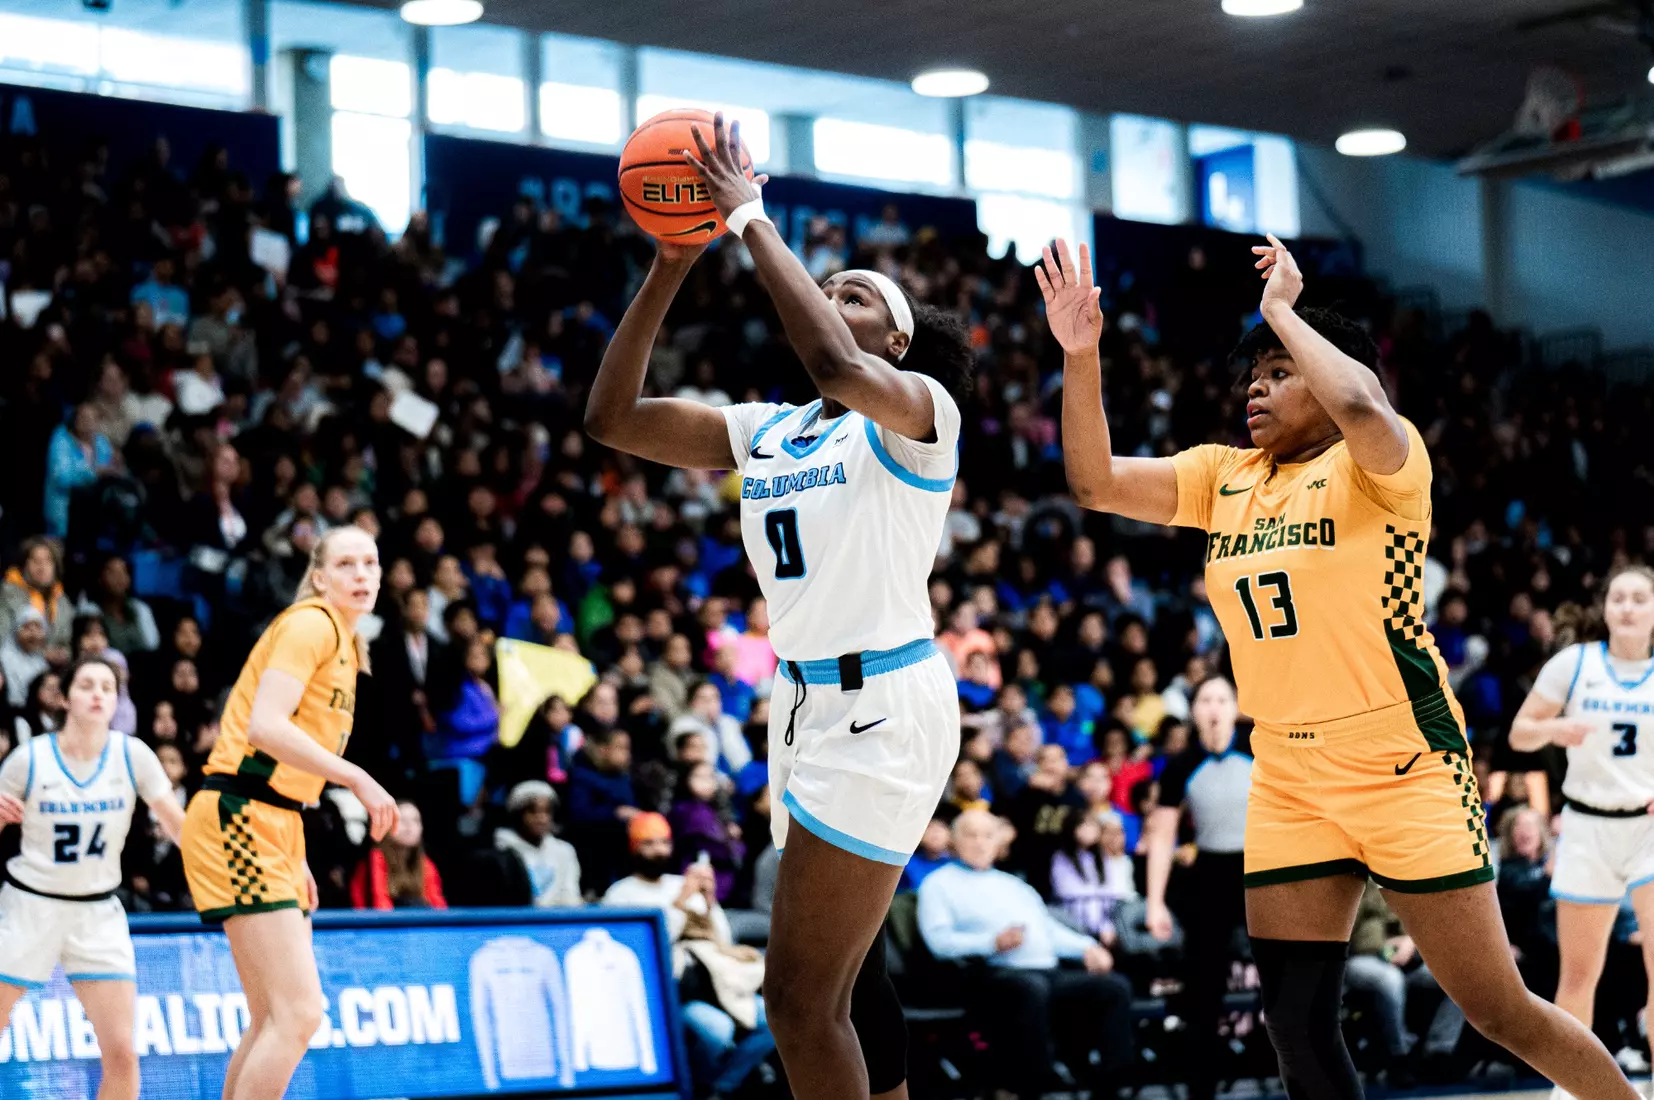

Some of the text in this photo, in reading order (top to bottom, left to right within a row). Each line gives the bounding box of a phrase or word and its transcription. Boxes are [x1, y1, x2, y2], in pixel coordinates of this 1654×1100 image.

[643, 182, 712, 204] ELITE
[741, 462, 846, 500] COLUMBIA
[1254, 512, 1286, 531] SAN
[764, 507, 807, 580] 0
[1206, 517, 1336, 566] FRANCISCO
[1234, 569, 1298, 640] 13
[1611, 722, 1637, 757] 3
[53, 823, 106, 863] 24
